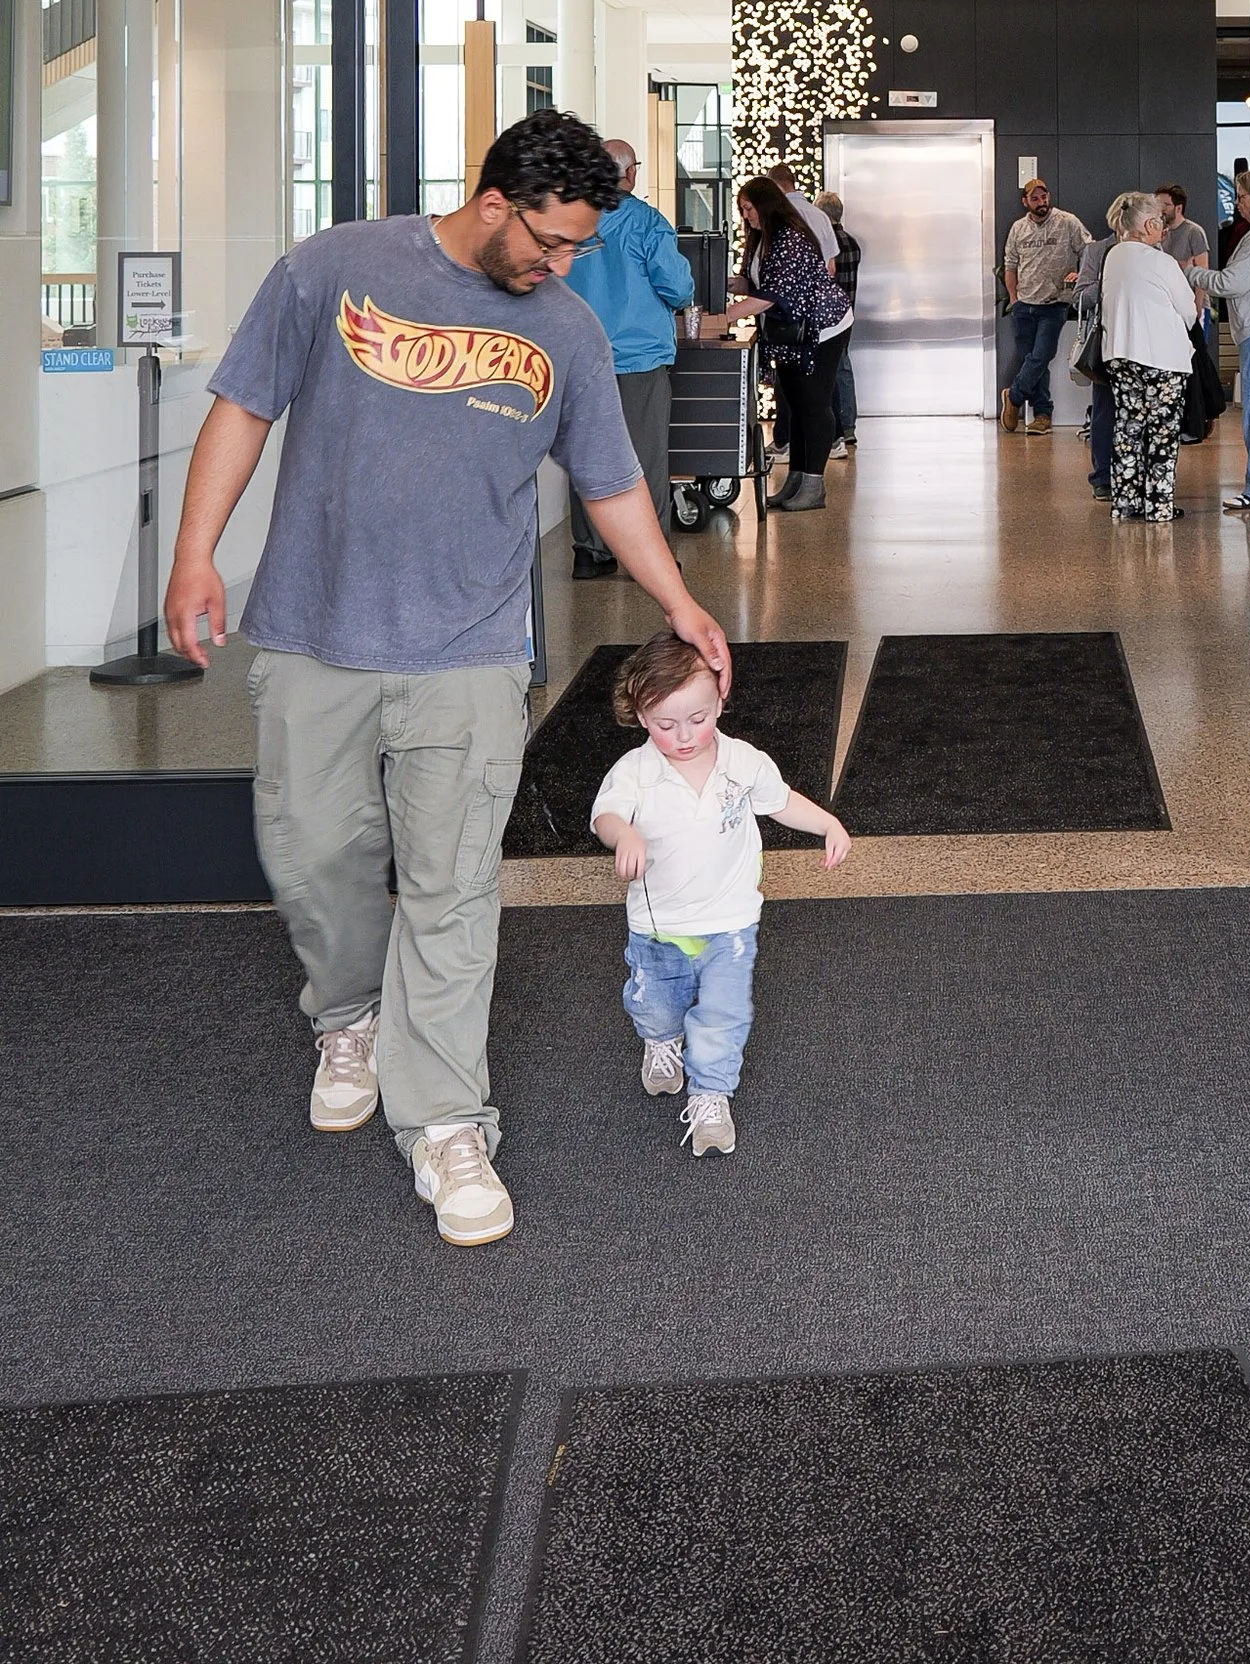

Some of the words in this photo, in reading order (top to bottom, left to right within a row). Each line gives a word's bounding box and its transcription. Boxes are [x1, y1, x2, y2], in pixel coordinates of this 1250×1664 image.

[132, 271, 166, 279] Purchase
[44, 352, 79, 367] STAND
[80, 351, 112, 366] CLEAR
[384, 332, 456, 387] GOD
[466, 396, 500, 414] Psalm
